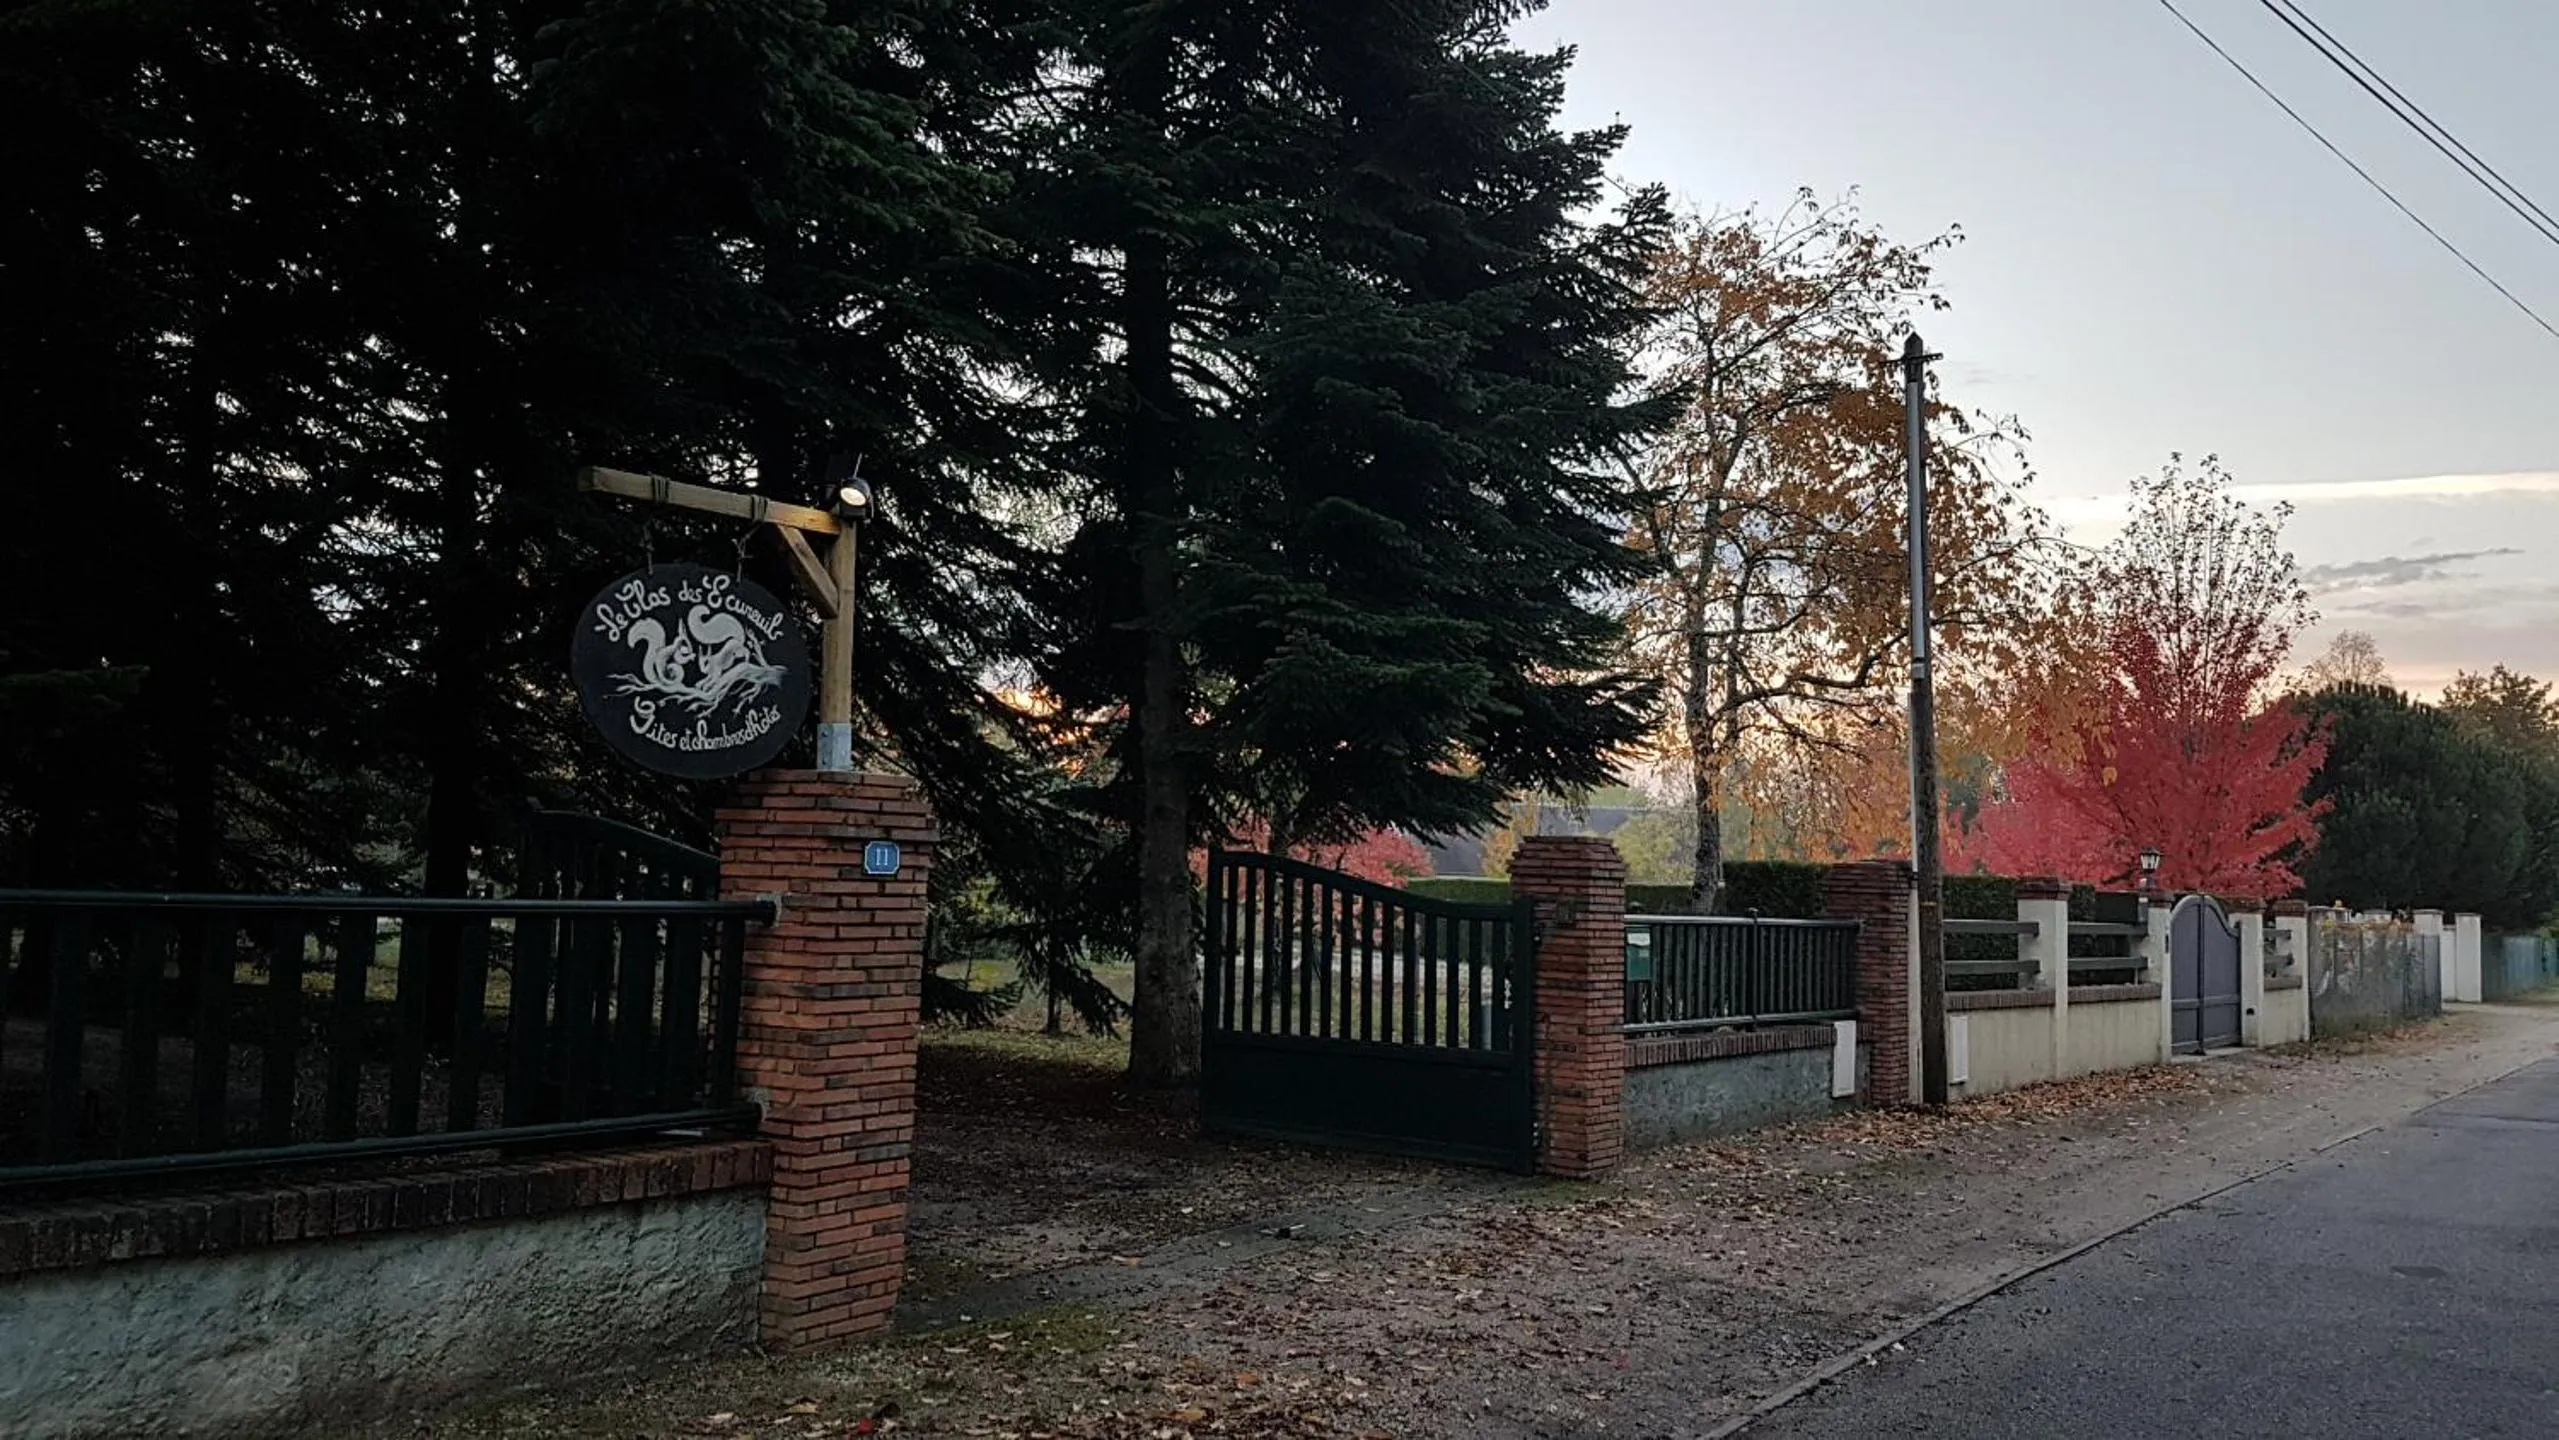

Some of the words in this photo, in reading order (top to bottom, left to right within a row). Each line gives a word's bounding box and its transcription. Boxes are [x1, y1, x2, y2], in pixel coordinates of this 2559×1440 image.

[594, 603, 629, 642] Le
[678, 580, 703, 603] des
[679, 727, 693, 751] et
[876, 848, 888, 866] 11
